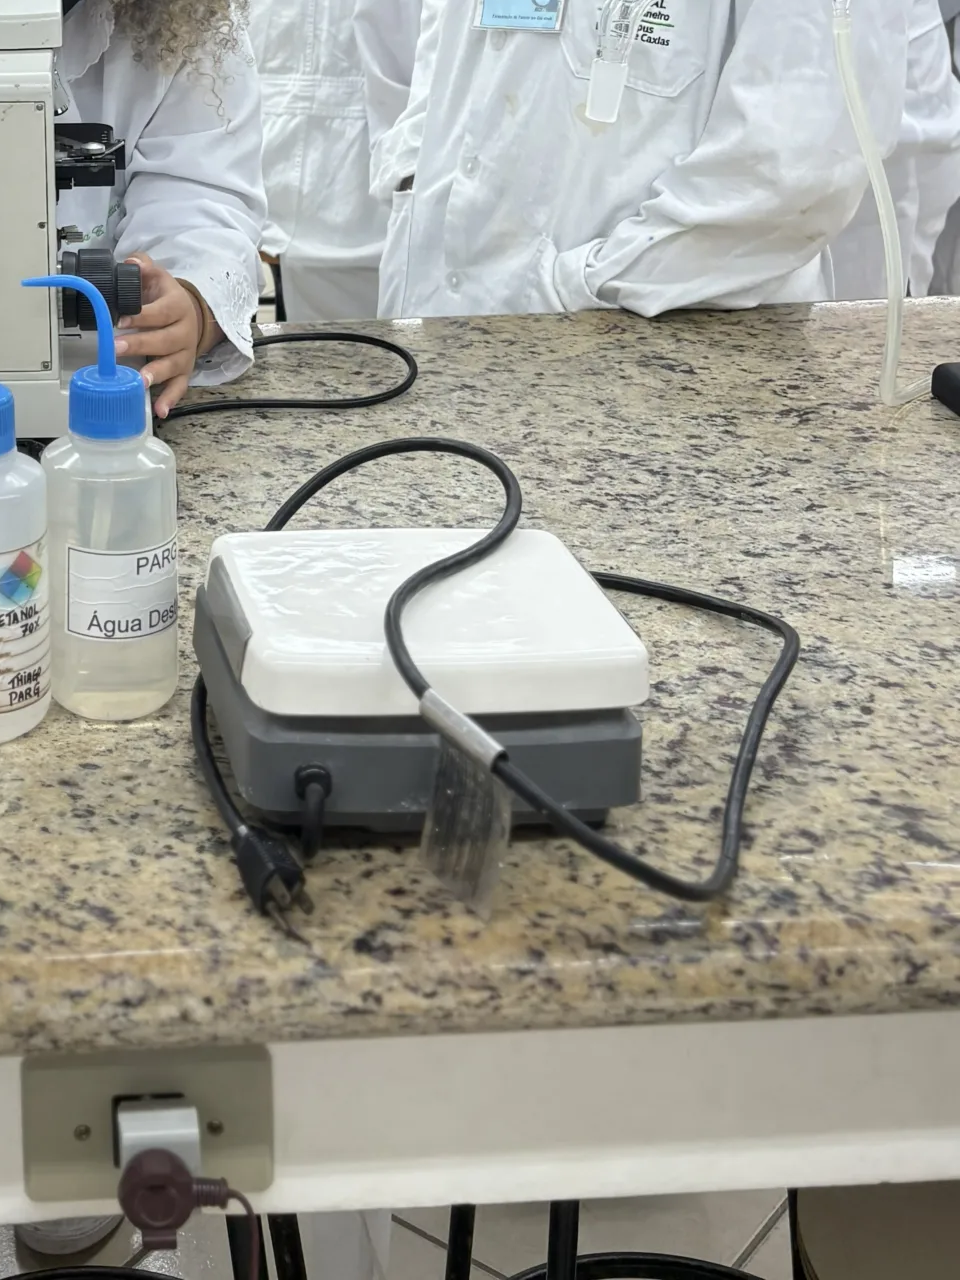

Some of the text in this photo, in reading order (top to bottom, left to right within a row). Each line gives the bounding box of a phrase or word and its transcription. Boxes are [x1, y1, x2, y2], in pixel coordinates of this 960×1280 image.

[640, 33, 671, 47] Caxias
[87, 610, 142, 638] Água
[8, 681, 41, 707] PARG
